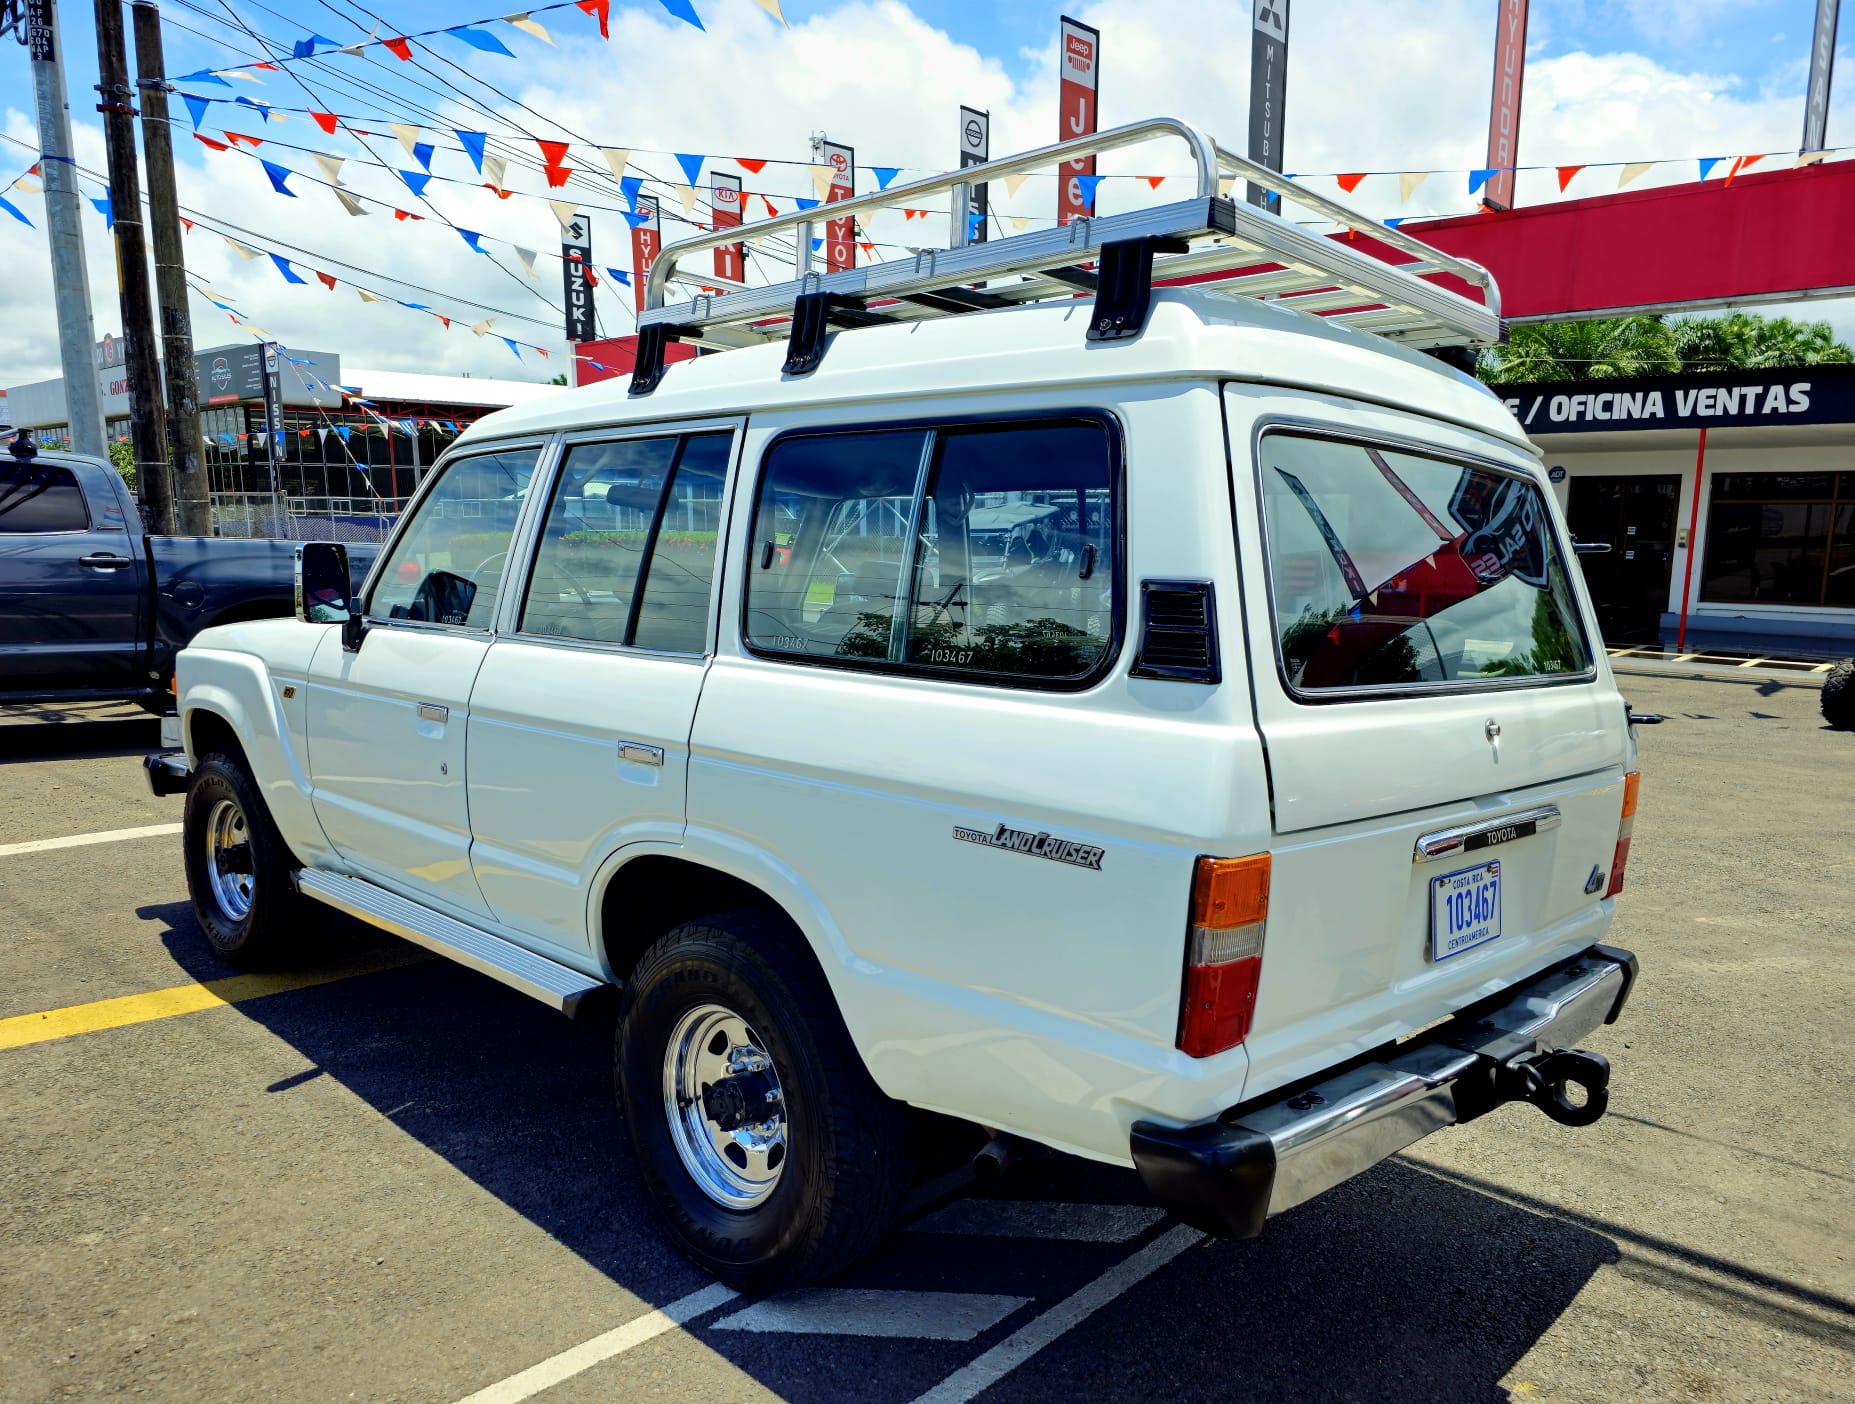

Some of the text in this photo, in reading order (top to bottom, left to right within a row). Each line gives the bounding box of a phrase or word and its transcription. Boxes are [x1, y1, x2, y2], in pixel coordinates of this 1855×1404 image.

[1070, 38, 1089, 56] Jeep
[718, 189, 735, 200] KIA
[570, 248, 586, 335] SUZUKI
[1549, 391, 1665, 422] OFICINA
[1675, 382, 1811, 417] VENTAS
[269, 375, 283, 457] NISSN
[1551, 470, 1565, 479] ADT
[772, 635, 809, 650] 103467
[930, 649, 974, 664] 103467
[953, 828, 988, 845] TOYOTA
[1487, 826, 1517, 845] TOYOTA
[1452, 872, 1484, 890] COSTA RICA
[1446, 879, 1498, 935] 103467
[1447, 926, 1490, 951] CENTROAMERICA
